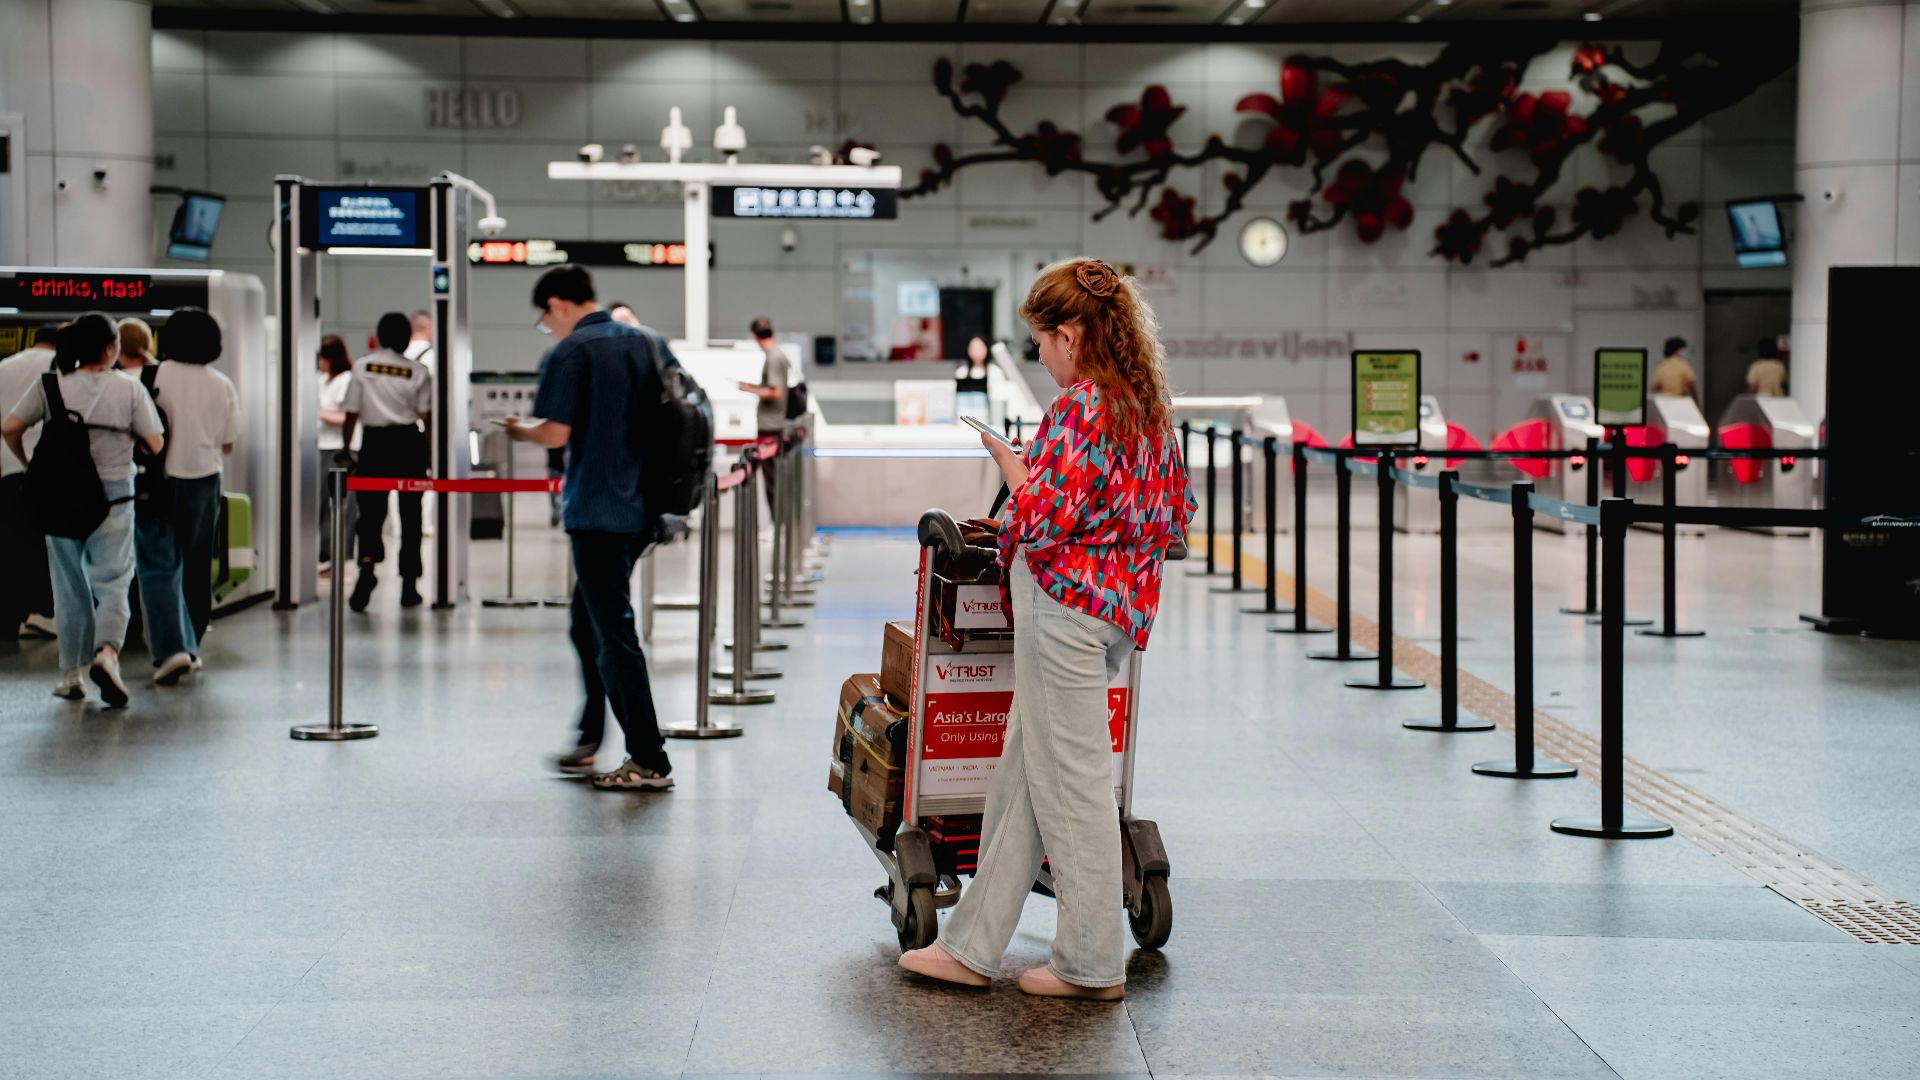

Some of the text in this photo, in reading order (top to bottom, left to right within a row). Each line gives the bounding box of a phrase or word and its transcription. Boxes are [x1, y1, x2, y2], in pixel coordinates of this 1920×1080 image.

[424, 87, 523, 128] HELLO
[31, 278, 97, 300] drinks,
[933, 711, 972, 724] Asia's
[940, 732, 966, 745] Only
[969, 731, 998, 743] Using
